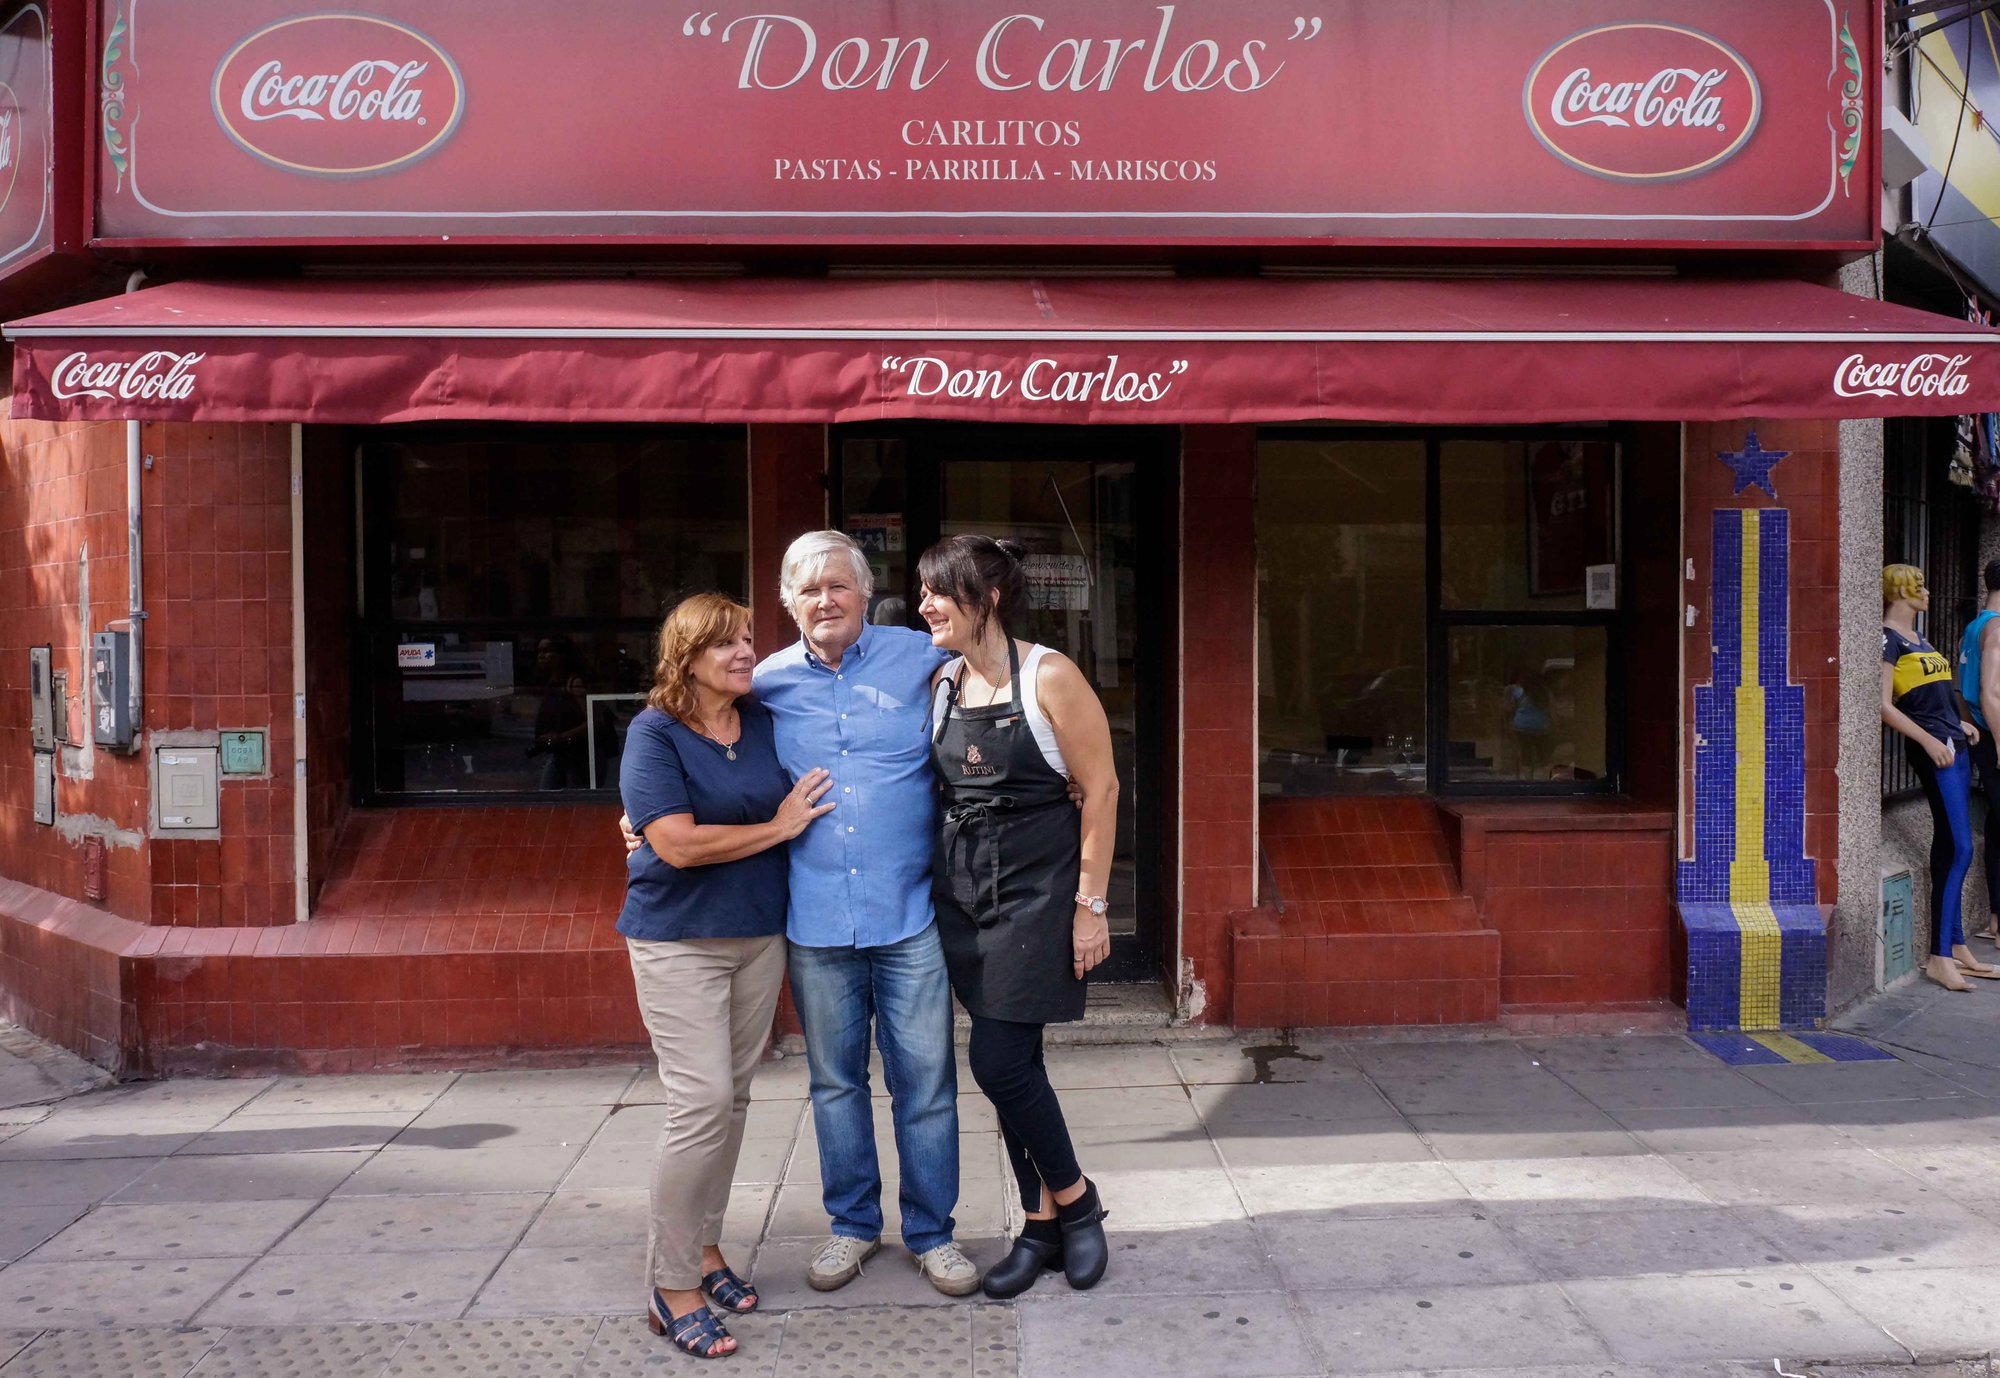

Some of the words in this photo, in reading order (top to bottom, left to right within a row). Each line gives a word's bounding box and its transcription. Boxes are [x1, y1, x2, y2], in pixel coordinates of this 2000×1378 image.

[682, 11, 949, 91] “Don
[975, 4, 1322, 93] Carlos”
[240, 58, 429, 122] Coca-Cola
[1550, 66, 1728, 129] Coca-Cola
[901, 119, 1081, 147] CARLITOS
[774, 158, 882, 181] PASTAS
[906, 159, 1046, 181] PARRILLA
[1070, 159, 1217, 182] MARISCOS
[51, 351, 206, 400] Coca-Cola
[881, 355, 1003, 400] “Don
[1020, 354, 1189, 403] Carlos”
[1833, 353, 1972, 398] Coca-Cola
[399, 648, 422, 657] AYUDA
